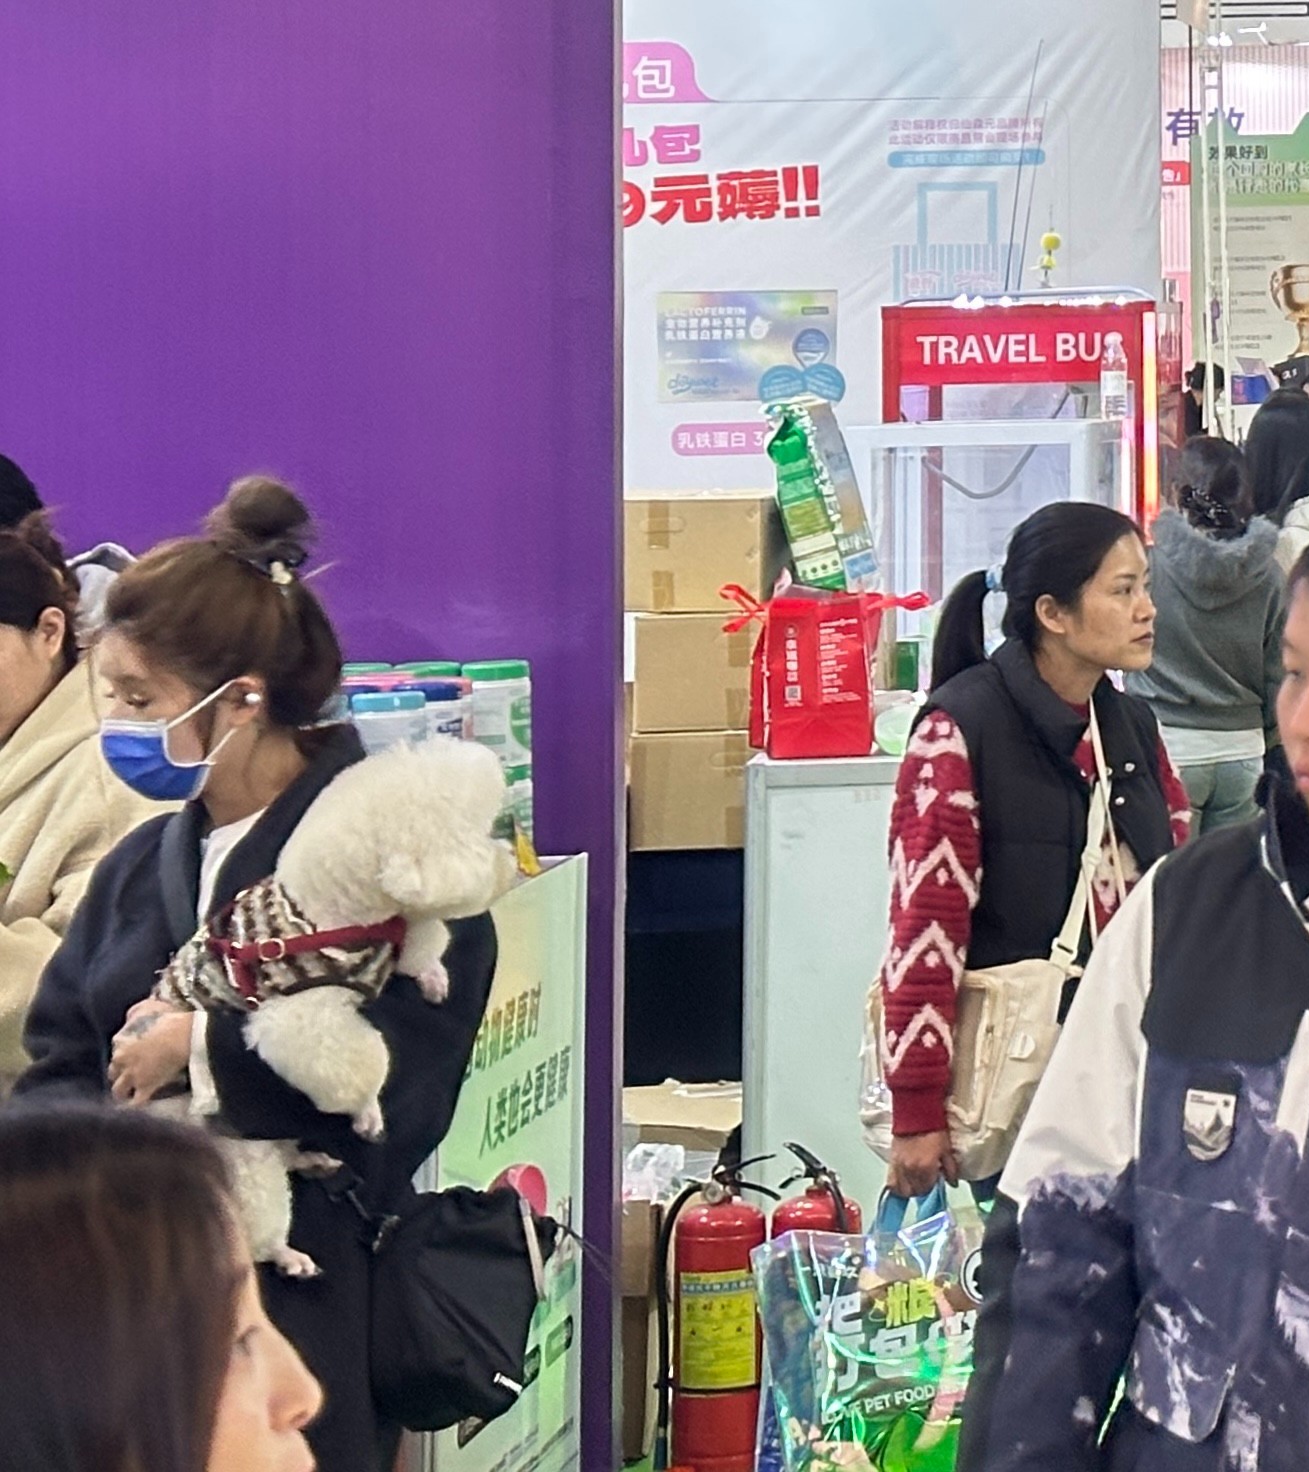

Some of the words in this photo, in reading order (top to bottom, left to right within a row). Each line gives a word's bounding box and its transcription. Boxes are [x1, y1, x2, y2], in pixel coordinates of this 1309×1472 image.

[623, 56, 675, 99] 包
[916, 333, 1047, 365] TRAVEL
[1056, 332, 1123, 362] BU
[677, 431, 746, 449] 乳铁蛋白
[479, 1045, 571, 1159] 人类也会更健康
[864, 1394, 891, 1414] PET
[894, 1384, 935, 1405] FOOD
